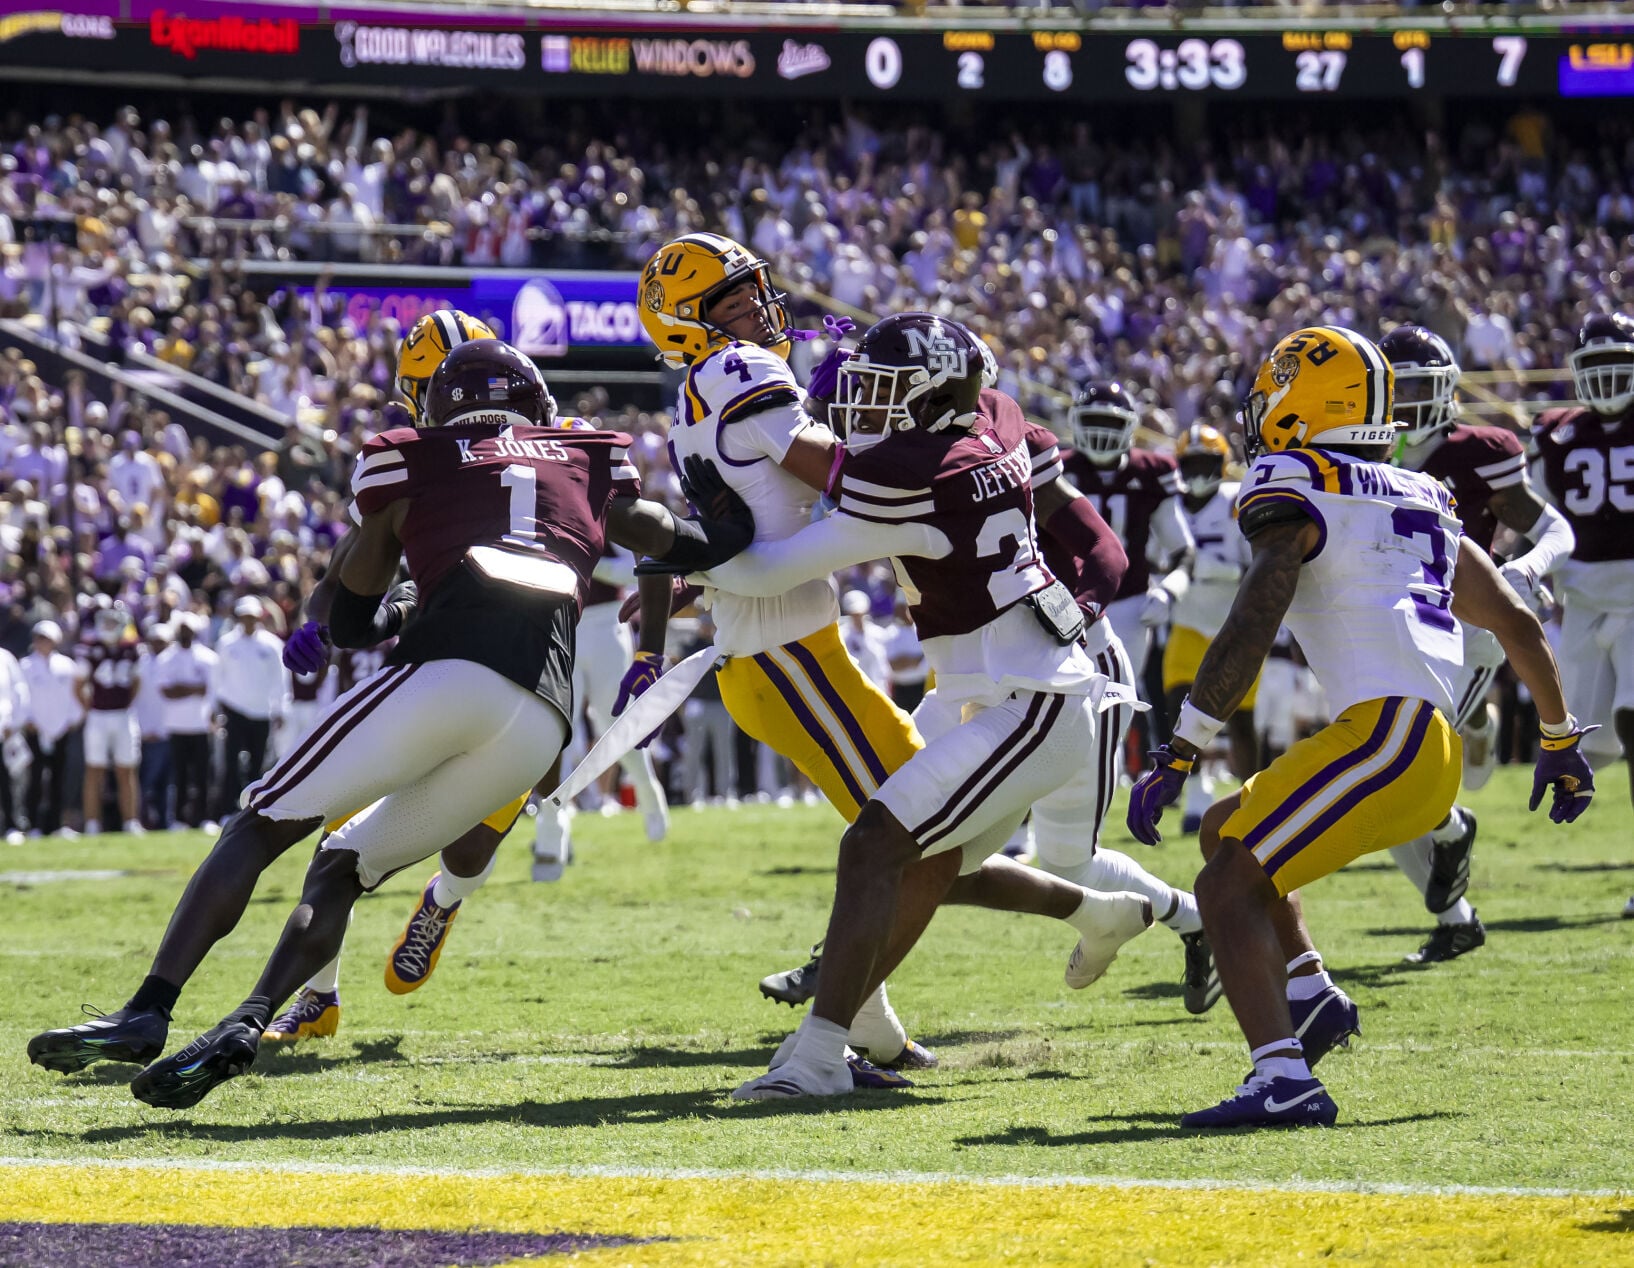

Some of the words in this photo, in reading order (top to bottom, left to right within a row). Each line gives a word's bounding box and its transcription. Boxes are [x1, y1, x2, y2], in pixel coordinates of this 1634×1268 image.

[355, 26, 411, 63] GOOD
[412, 28, 526, 70] MOLECULES
[631, 38, 756, 78] WINDOWS
[866, 36, 901, 89] 0
[1125, 38, 1248, 90] 3:33
[1401, 48, 1425, 88] 1
[1493, 37, 1527, 86] 7
[1568, 44, 1633, 70] LSU
[957, 51, 985, 89] 2
[1043, 50, 1074, 91] 8
[1296, 50, 1347, 91] 27
[565, 301, 639, 341] TACO
[723, 352, 753, 384] 4
[455, 438, 483, 463] K.
[494, 439, 569, 462] JONES
[1563, 444, 1634, 517] 35
[501, 464, 546, 551] 1
[975, 507, 1056, 610] 2
